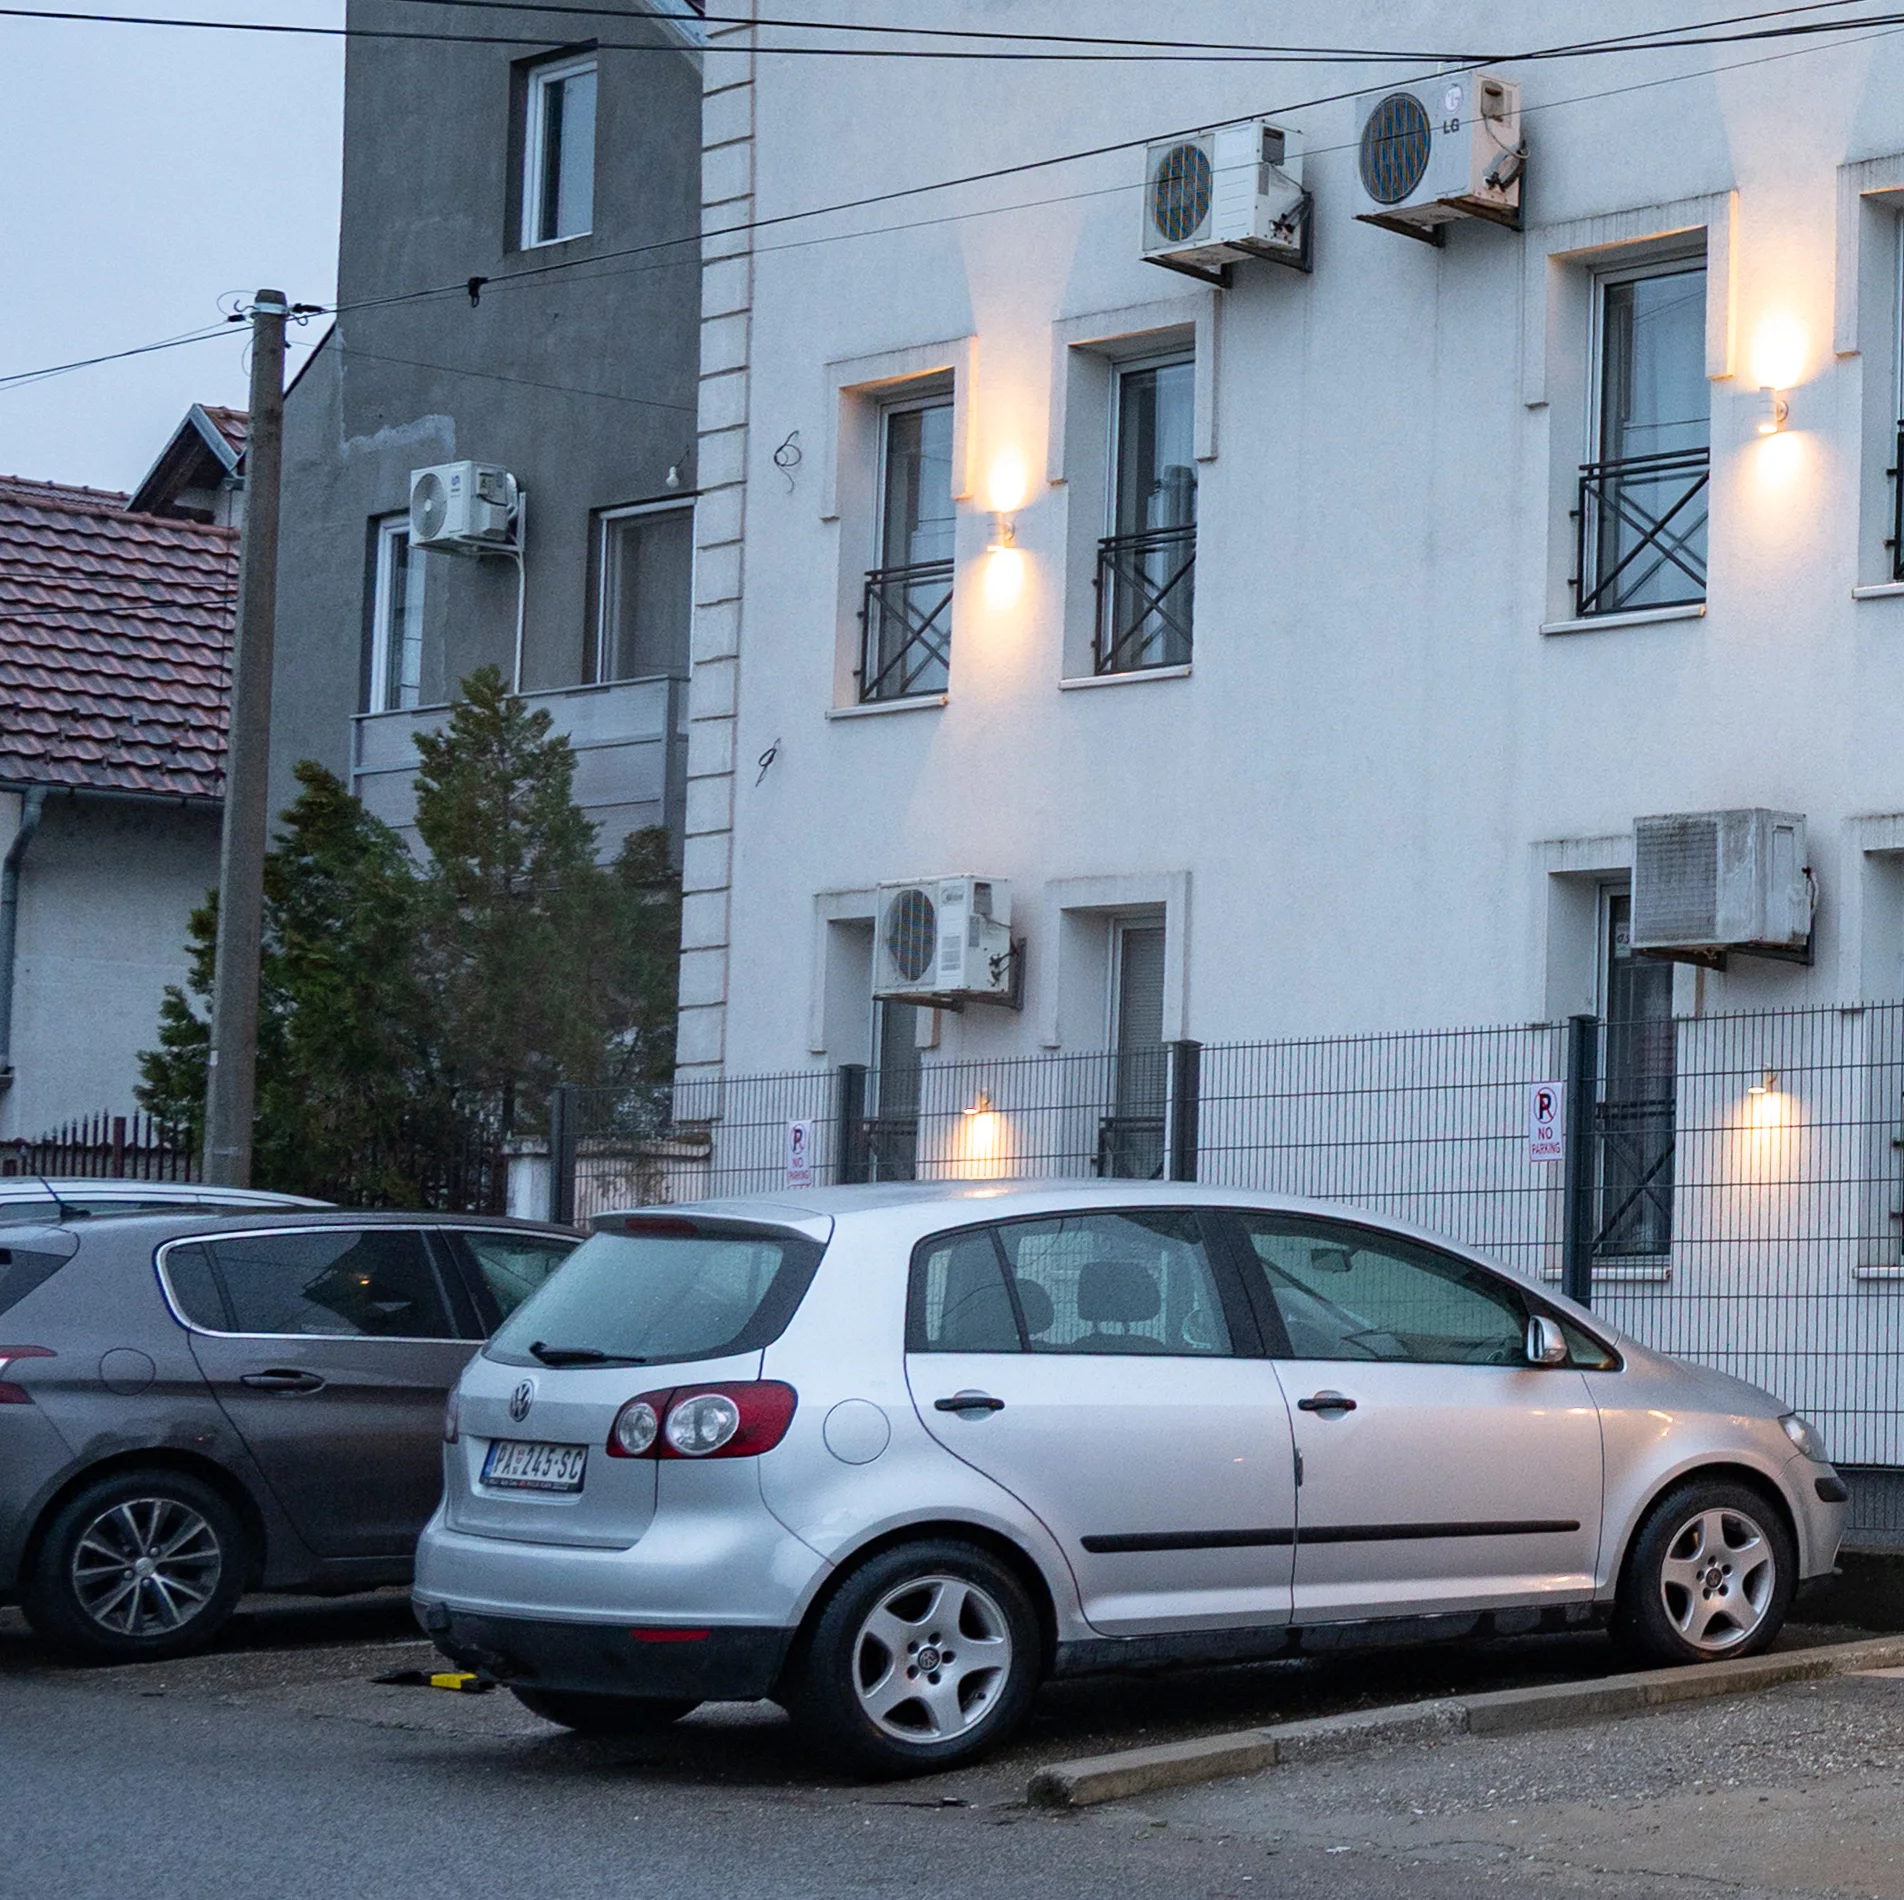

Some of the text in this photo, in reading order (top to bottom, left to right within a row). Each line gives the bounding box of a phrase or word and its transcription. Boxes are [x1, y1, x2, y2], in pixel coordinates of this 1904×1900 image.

[1443, 118, 1460, 135] LG
[1537, 1126, 1553, 1141] NO
[1531, 1142, 1561, 1155] PARKING
[493, 1443, 516, 1475] PA
